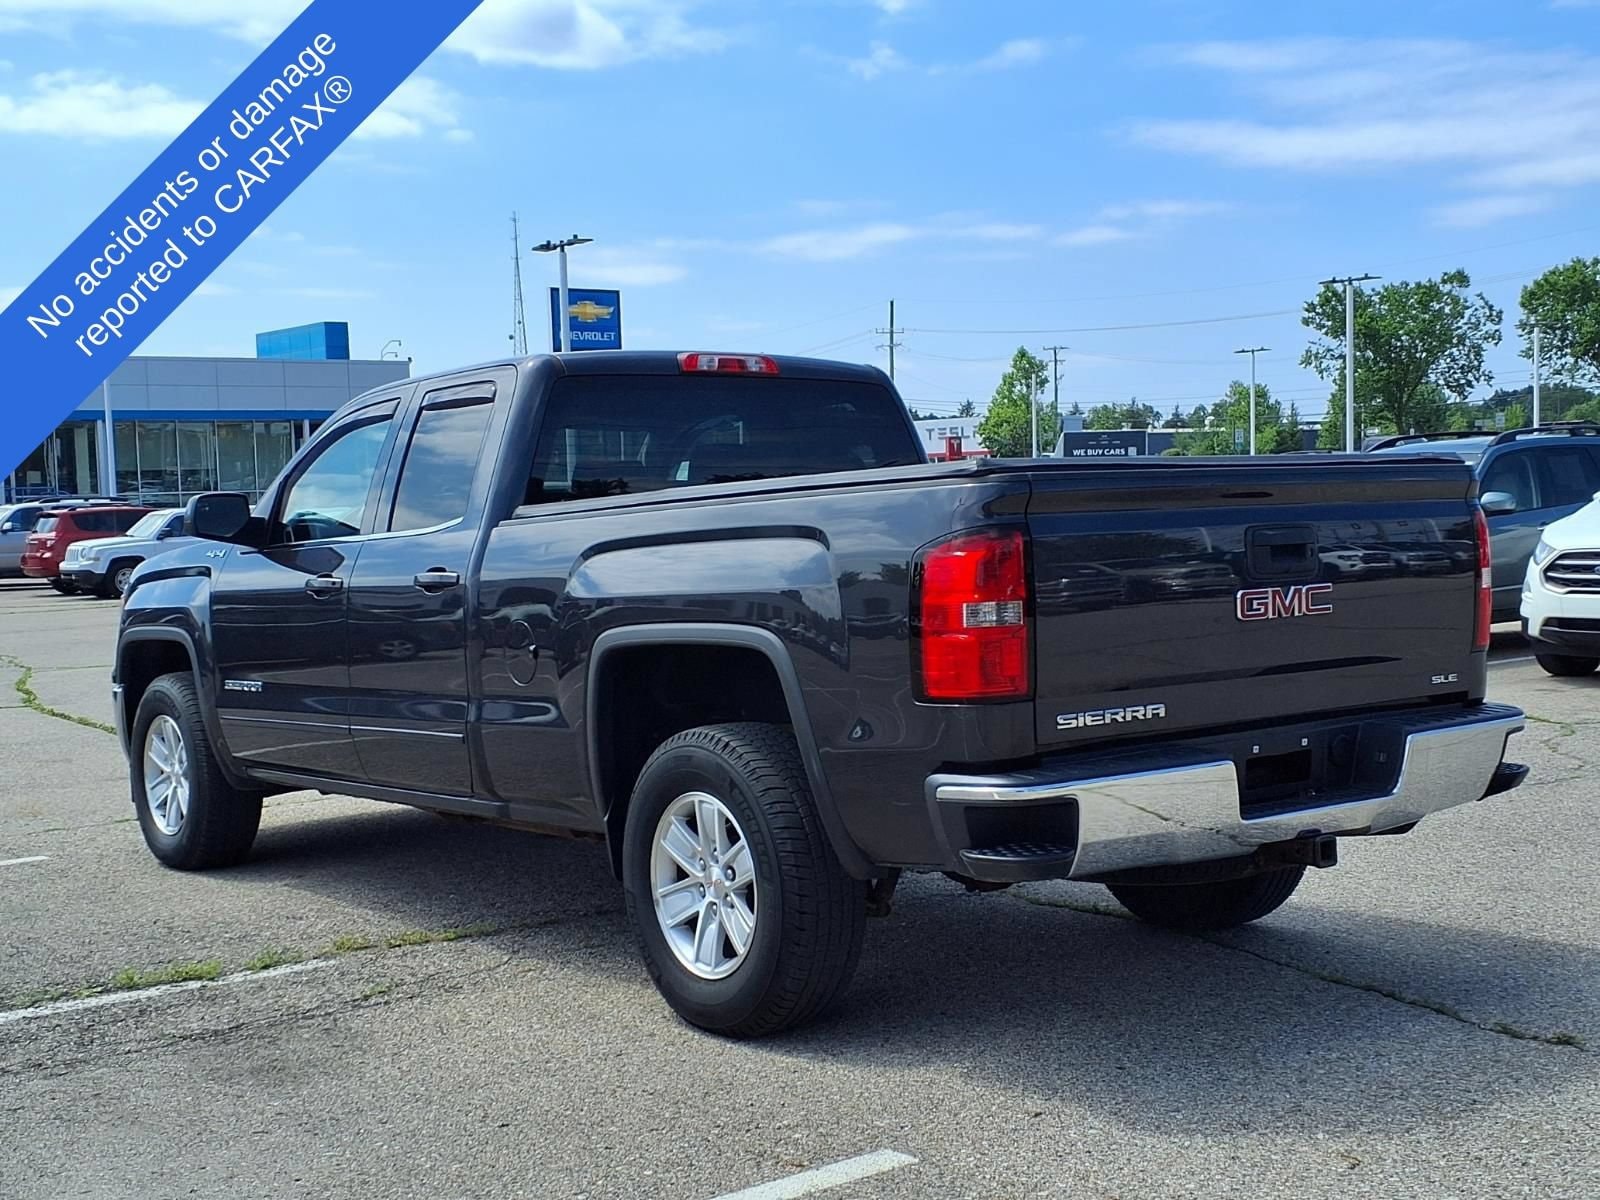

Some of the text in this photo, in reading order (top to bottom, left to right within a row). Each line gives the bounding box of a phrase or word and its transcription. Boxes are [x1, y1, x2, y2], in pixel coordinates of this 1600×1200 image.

[570, 331, 615, 341] EVROLET
[1072, 448, 1086, 456] WE
[1104, 447, 1125, 455] CARS
[1236, 583, 1333, 621] GMC
[1431, 673, 1458, 685] SLE
[1056, 703, 1167, 730] SIERRA
